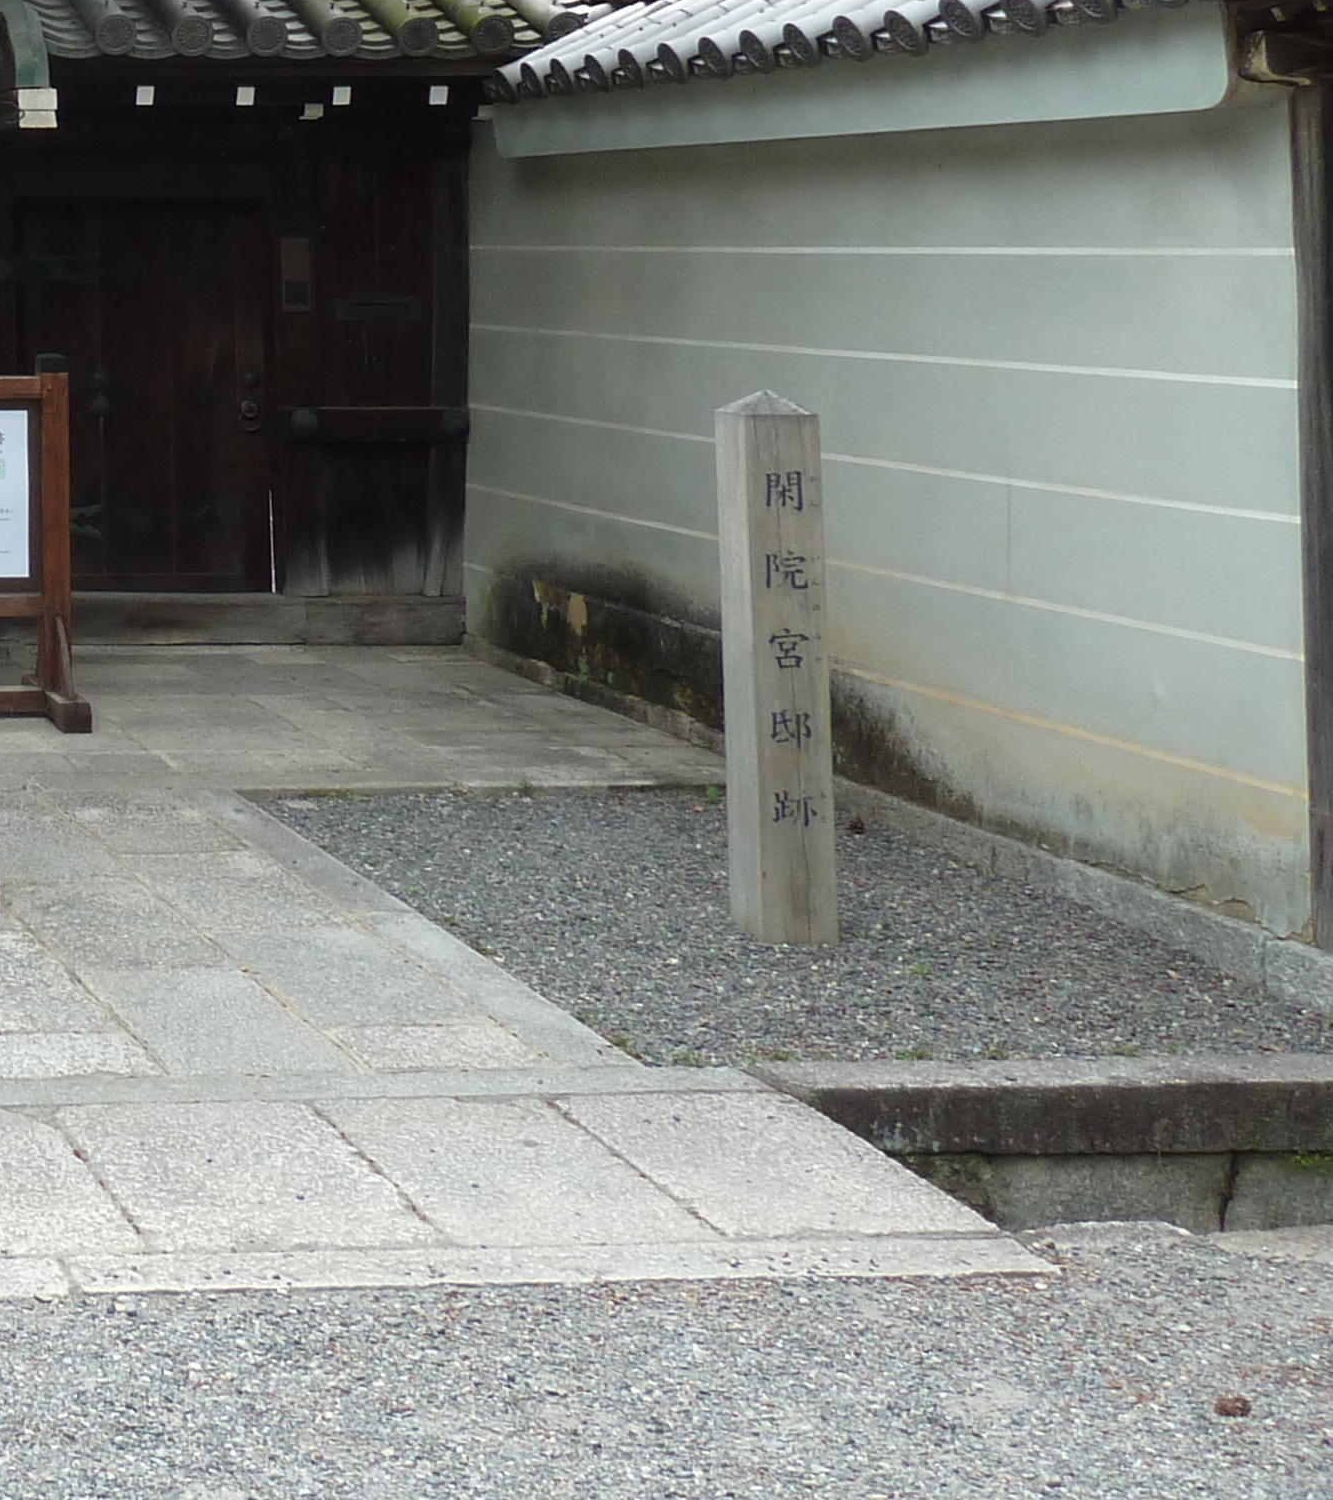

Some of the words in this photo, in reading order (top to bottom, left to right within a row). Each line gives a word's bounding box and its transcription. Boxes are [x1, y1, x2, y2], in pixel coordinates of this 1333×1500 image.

[765, 470, 818, 828] 閑院宮邸跡
